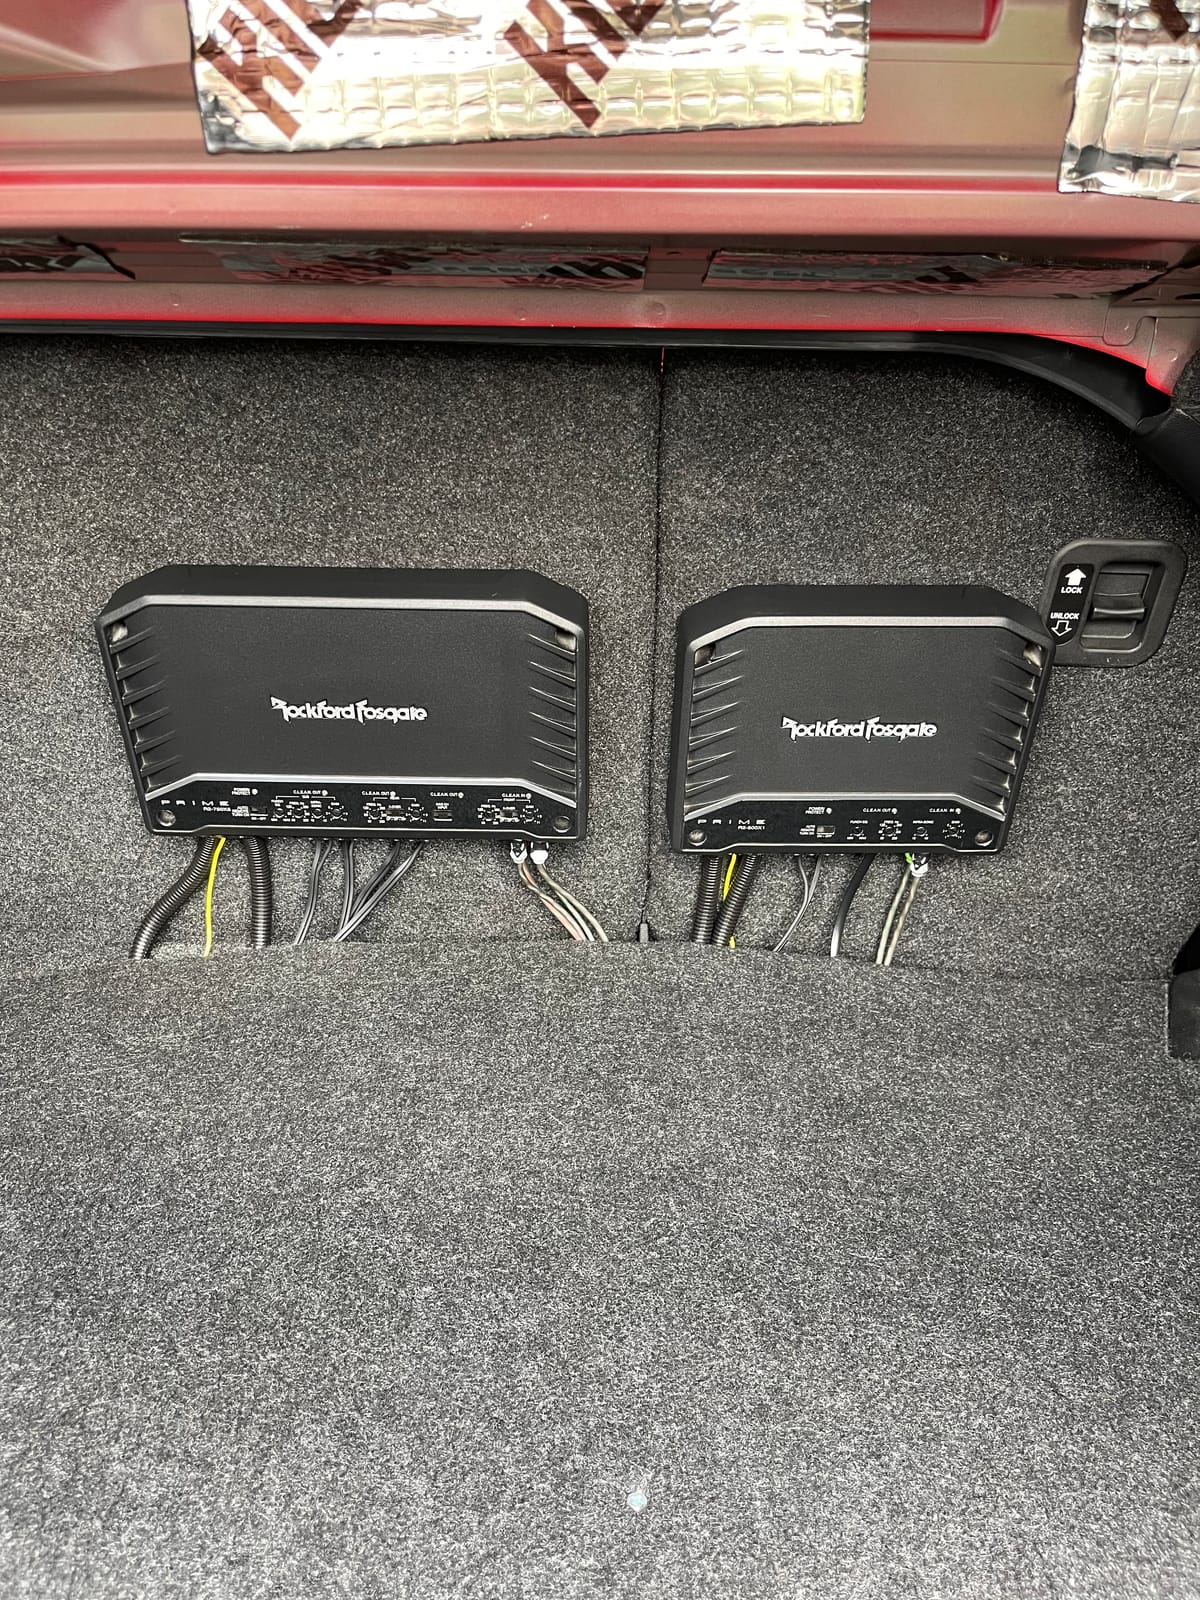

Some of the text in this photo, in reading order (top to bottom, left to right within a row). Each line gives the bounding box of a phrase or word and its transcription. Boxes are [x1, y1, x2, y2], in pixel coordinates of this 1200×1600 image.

[1061, 586, 1083, 594] LOCK
[1050, 612, 1080, 620] UNLOCK
[270, 696, 355, 722] Rockford
[781, 716, 865, 741] Rockford
[161, 799, 230, 807] PRIME
